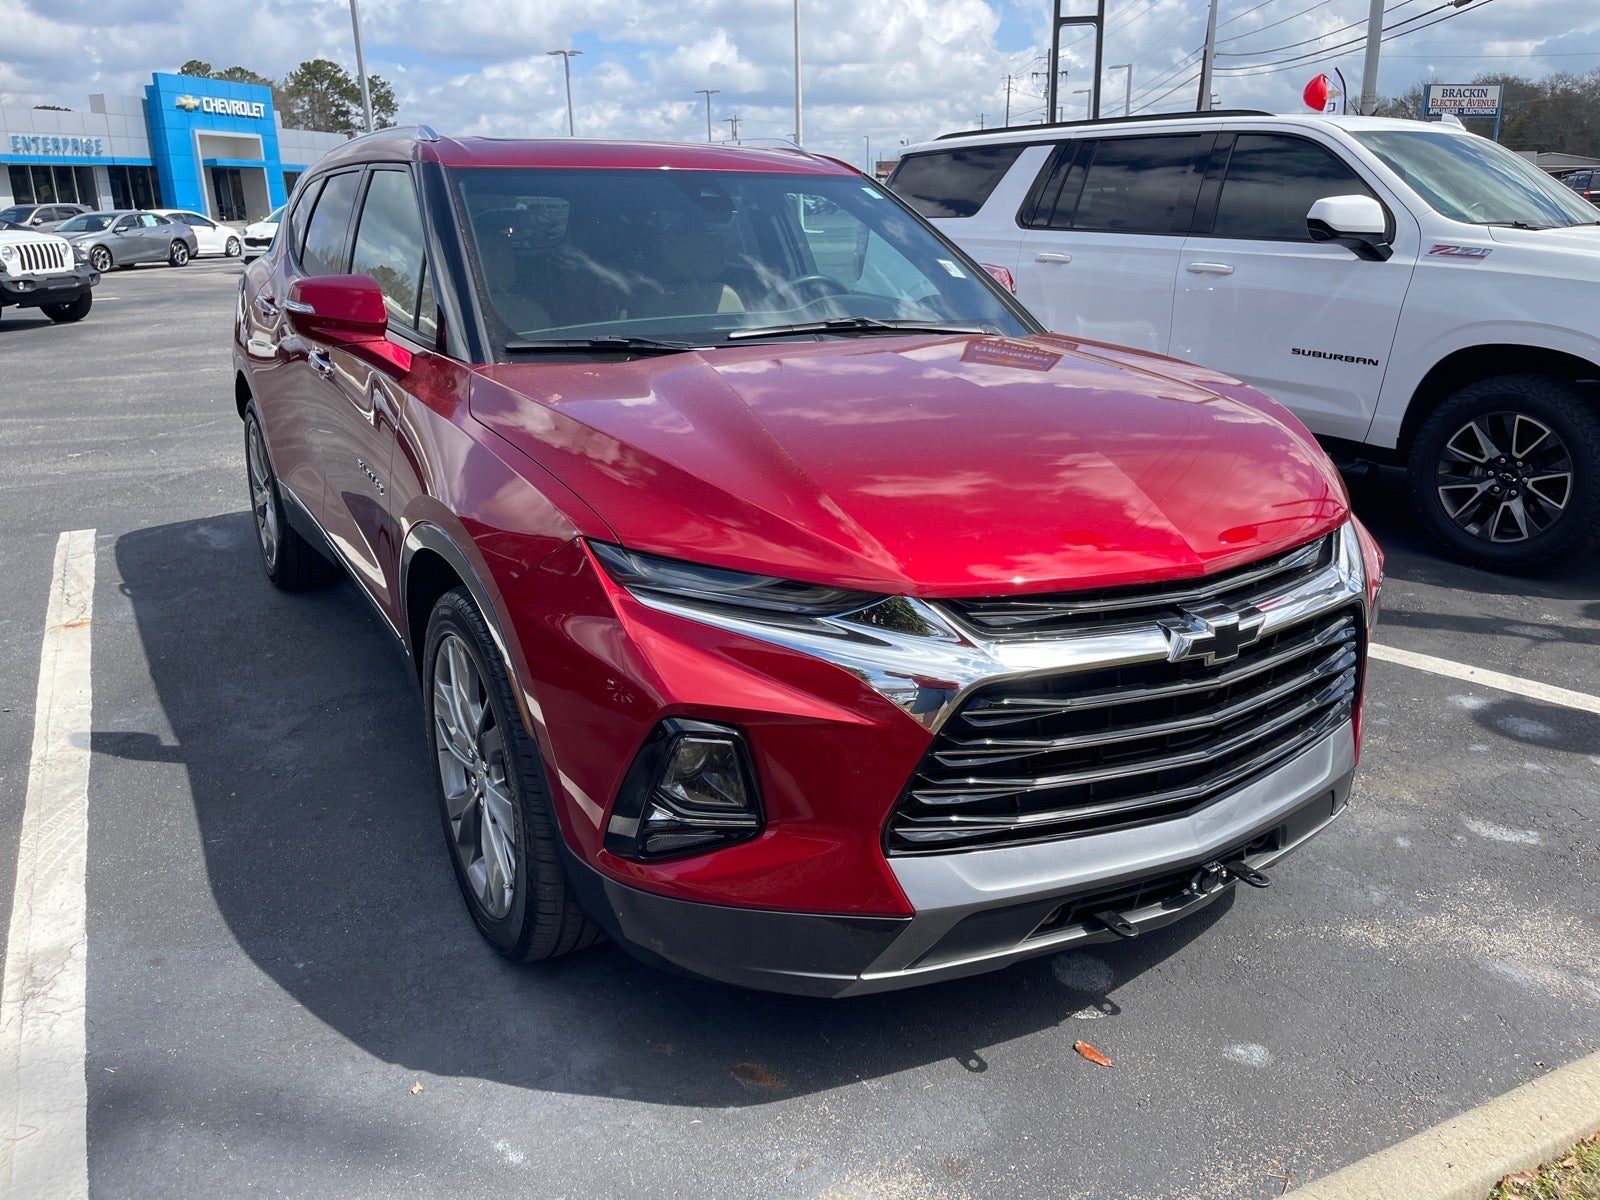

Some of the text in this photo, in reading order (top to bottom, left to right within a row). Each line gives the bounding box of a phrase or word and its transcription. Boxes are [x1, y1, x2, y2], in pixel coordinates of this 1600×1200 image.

[1431, 98, 1497, 107] ELECTRIC AVENUE
[1442, 88, 1489, 98] BRACKIN
[202, 97, 265, 118] CHEVROLET
[11, 135, 103, 154] ENTERPRISE
[1291, 347, 1379, 366] SUBURBAN
